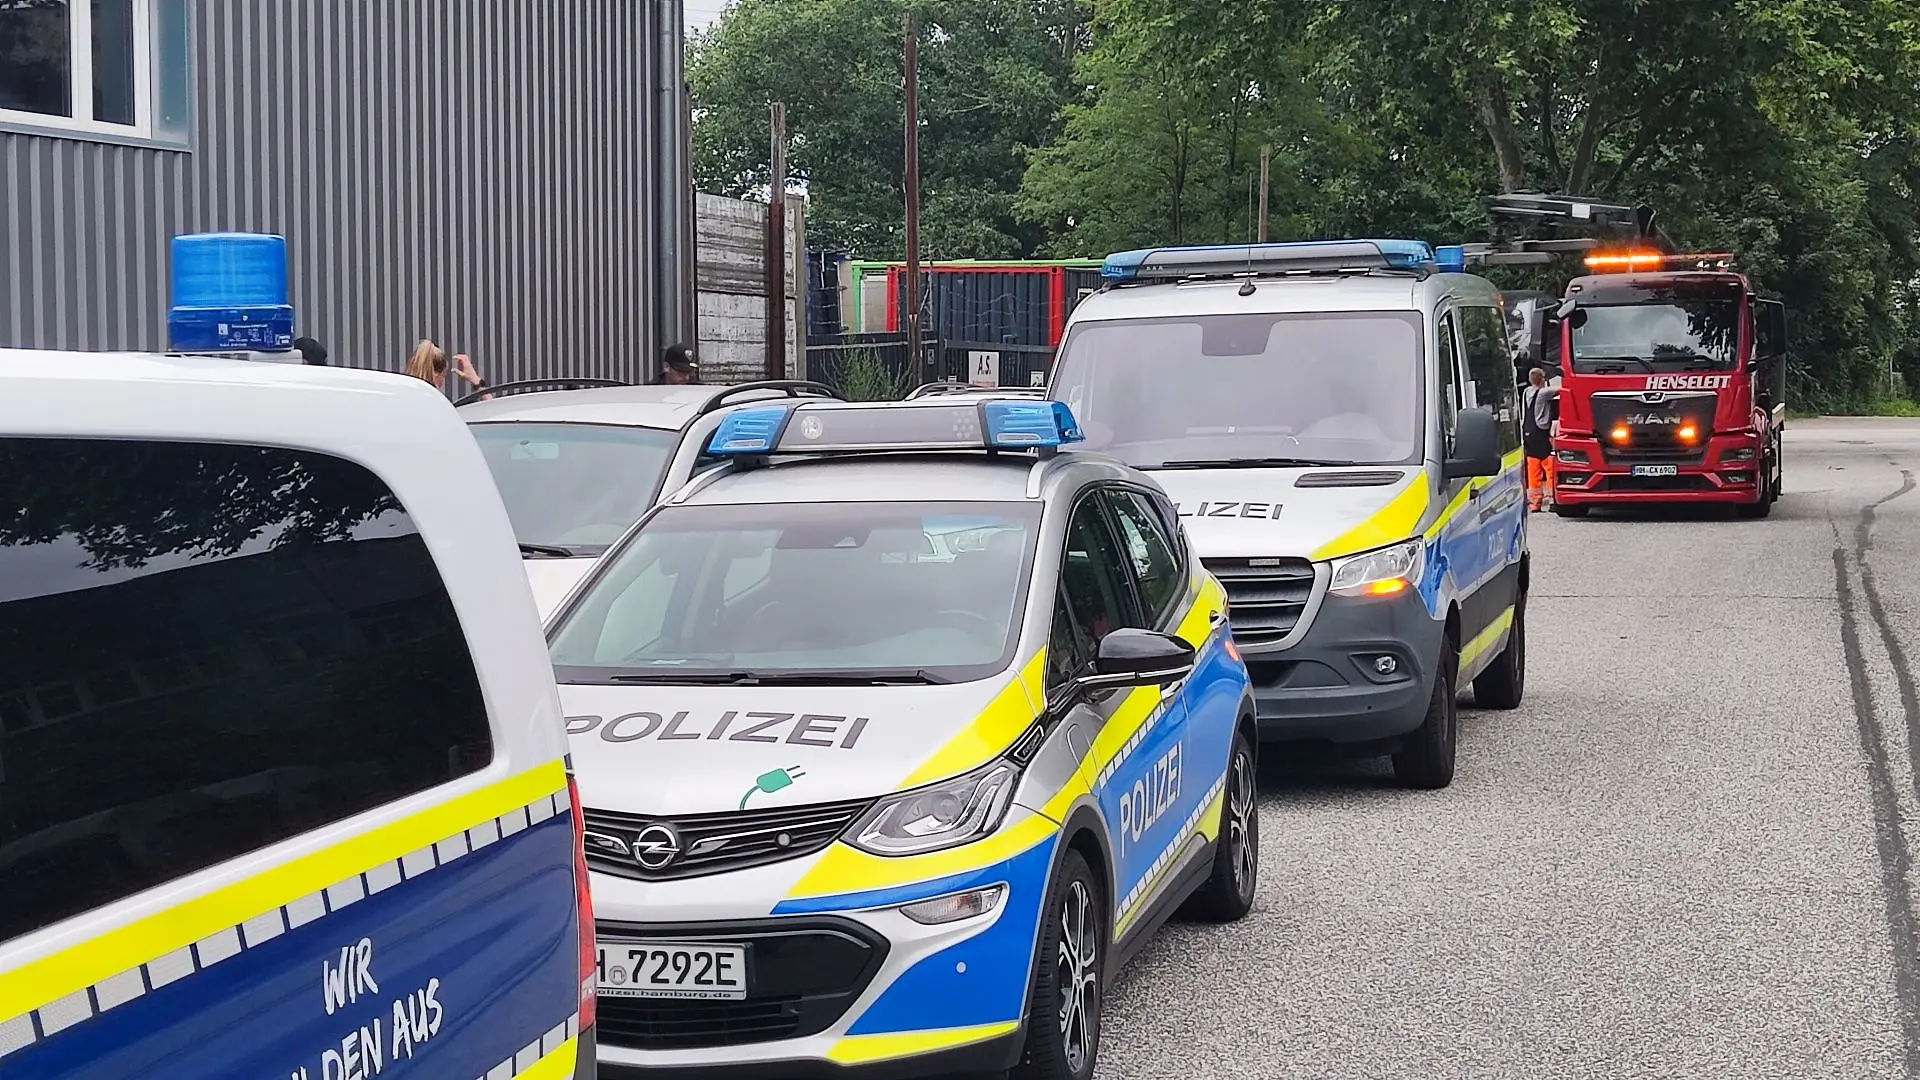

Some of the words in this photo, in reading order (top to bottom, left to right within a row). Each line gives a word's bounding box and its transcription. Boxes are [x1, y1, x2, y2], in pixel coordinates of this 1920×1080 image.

[1645, 375, 1732, 390] HENSELEIT
[1174, 501, 1283, 520] LIZEI
[563, 710, 870, 749] POLIZEI
[1119, 740, 1183, 859] POLIZEI
[323, 936, 379, 1016] WIR
[628, 949, 737, 986] 7292E
[597, 989, 732, 999] olizei.hamburg.de
[392, 977, 443, 1060] AUS
